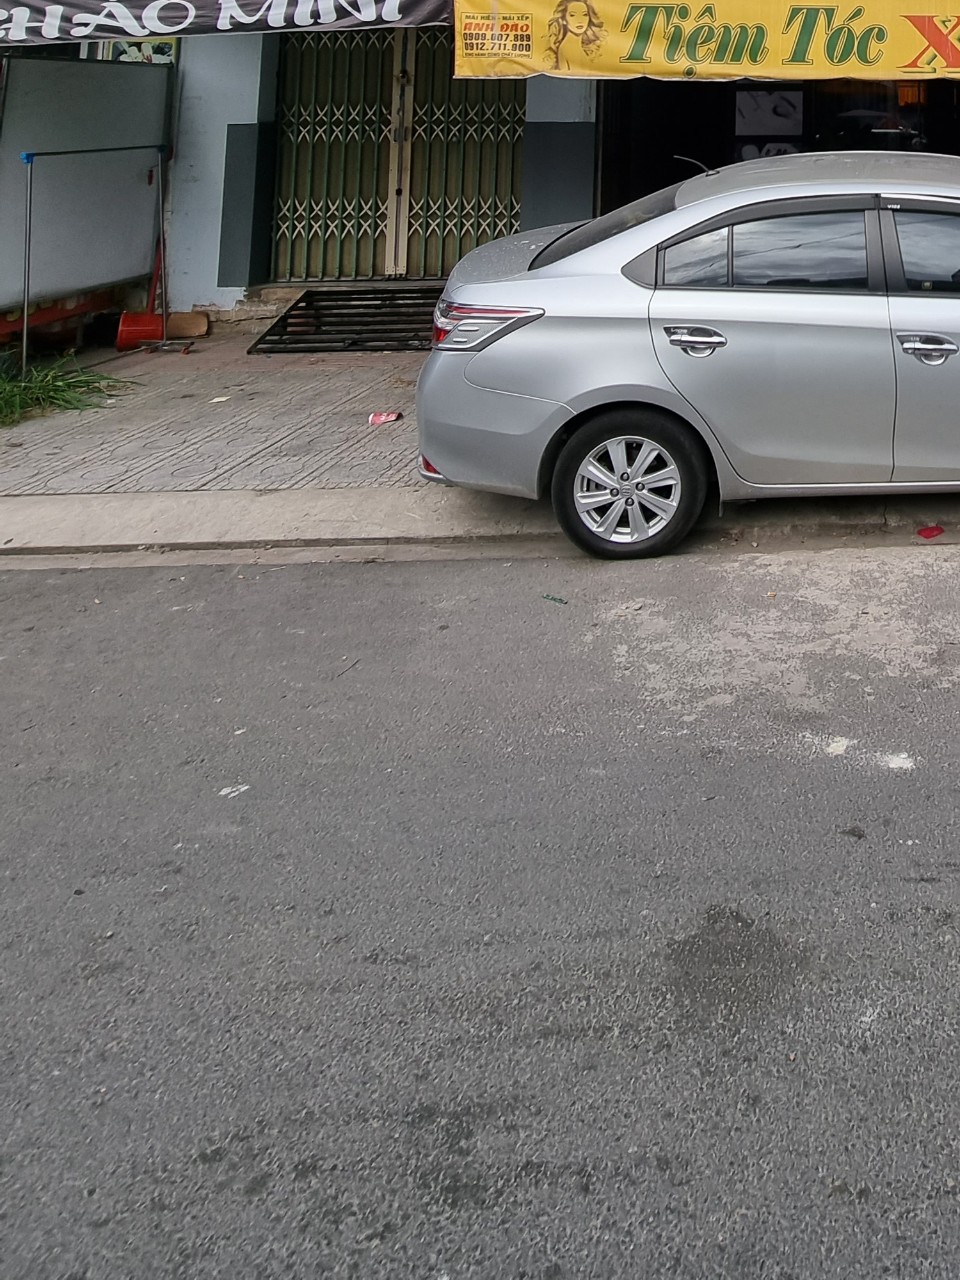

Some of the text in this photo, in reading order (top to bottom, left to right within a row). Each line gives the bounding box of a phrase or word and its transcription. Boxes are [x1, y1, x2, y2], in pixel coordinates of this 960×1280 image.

[463, 32, 531, 42] 0909.007.889
[619, 3, 769, 78] Tiệm
[782, 5, 888, 67] Tóc
[464, 42, 531, 52] 0912.711.900
